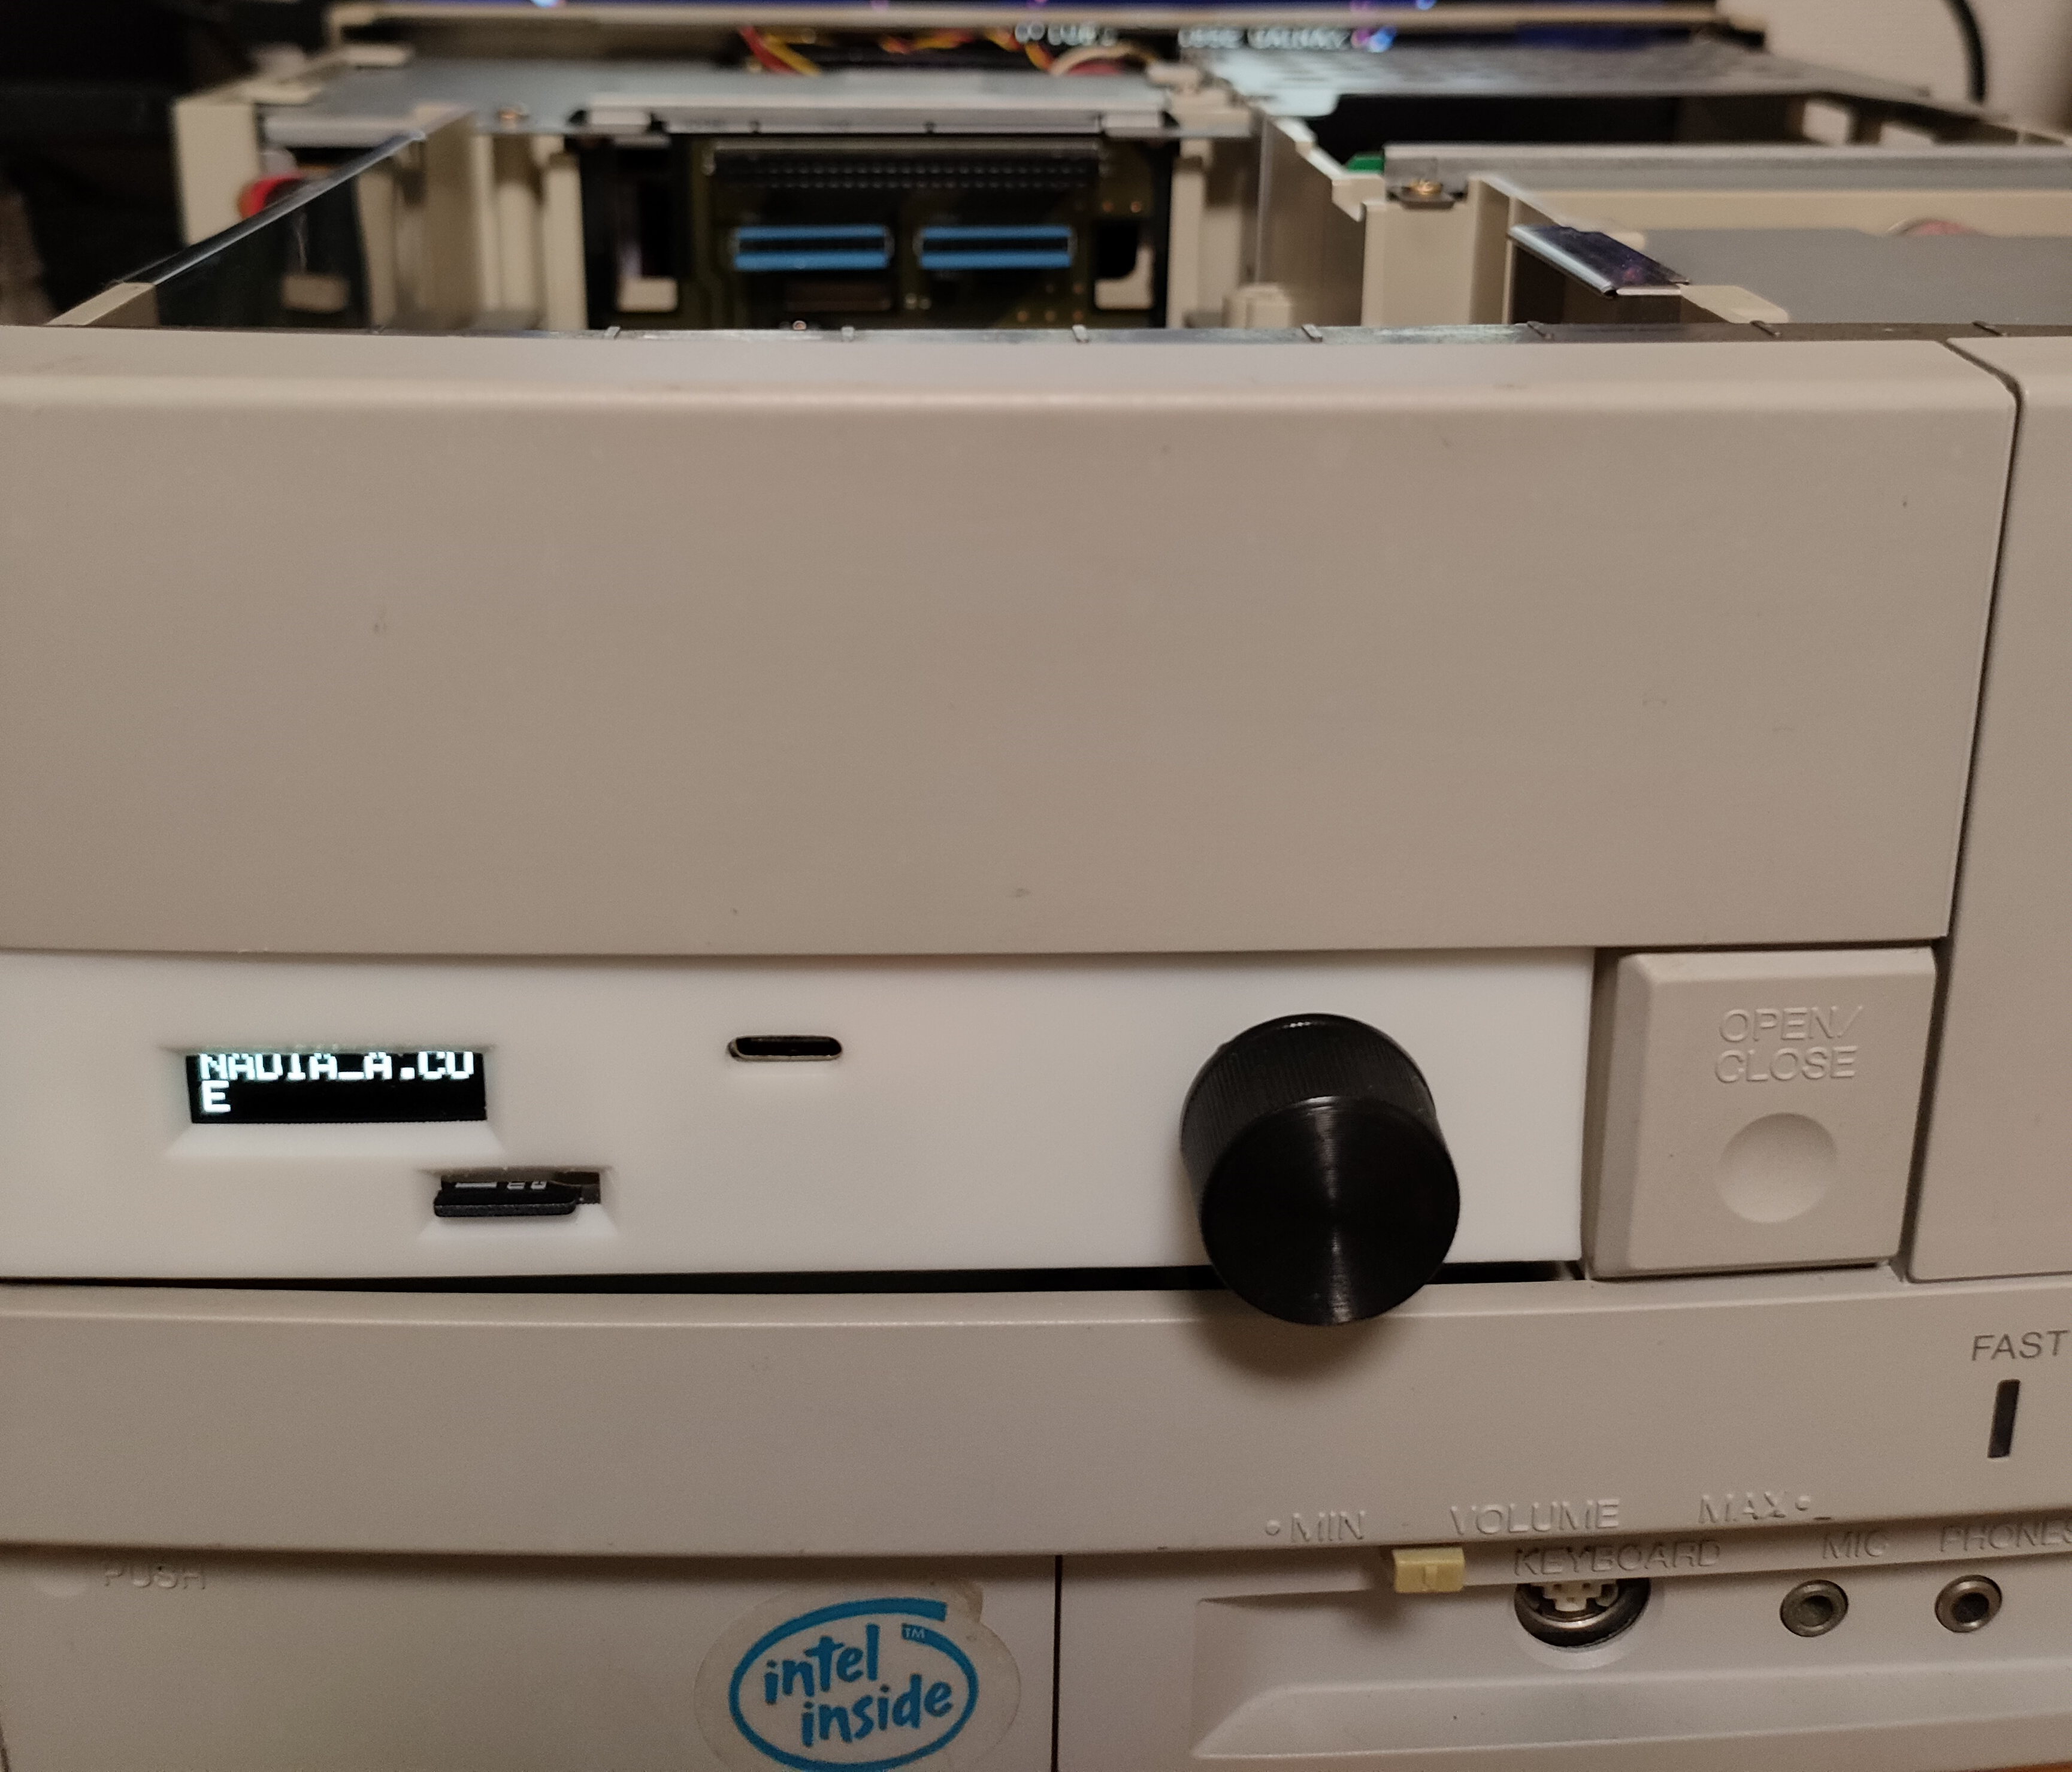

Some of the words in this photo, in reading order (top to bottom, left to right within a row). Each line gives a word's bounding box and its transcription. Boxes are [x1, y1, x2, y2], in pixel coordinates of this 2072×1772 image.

[1715, 1046, 1857, 1083] CLOSE
[201, 1080, 231, 1113] E
[1971, 1329, 2070, 1361] FAST
[1450, 1498, 1620, 1535] VOLUME
[1514, 1539, 1720, 1576] KEYBOARD
[1823, 1530, 1888, 1559] MIC
[103, 1562, 206, 1590] PUSH
[904, 1628, 925, 1638] TM
[764, 1623, 880, 1706] intel
[801, 1674, 954, 1747] inside
